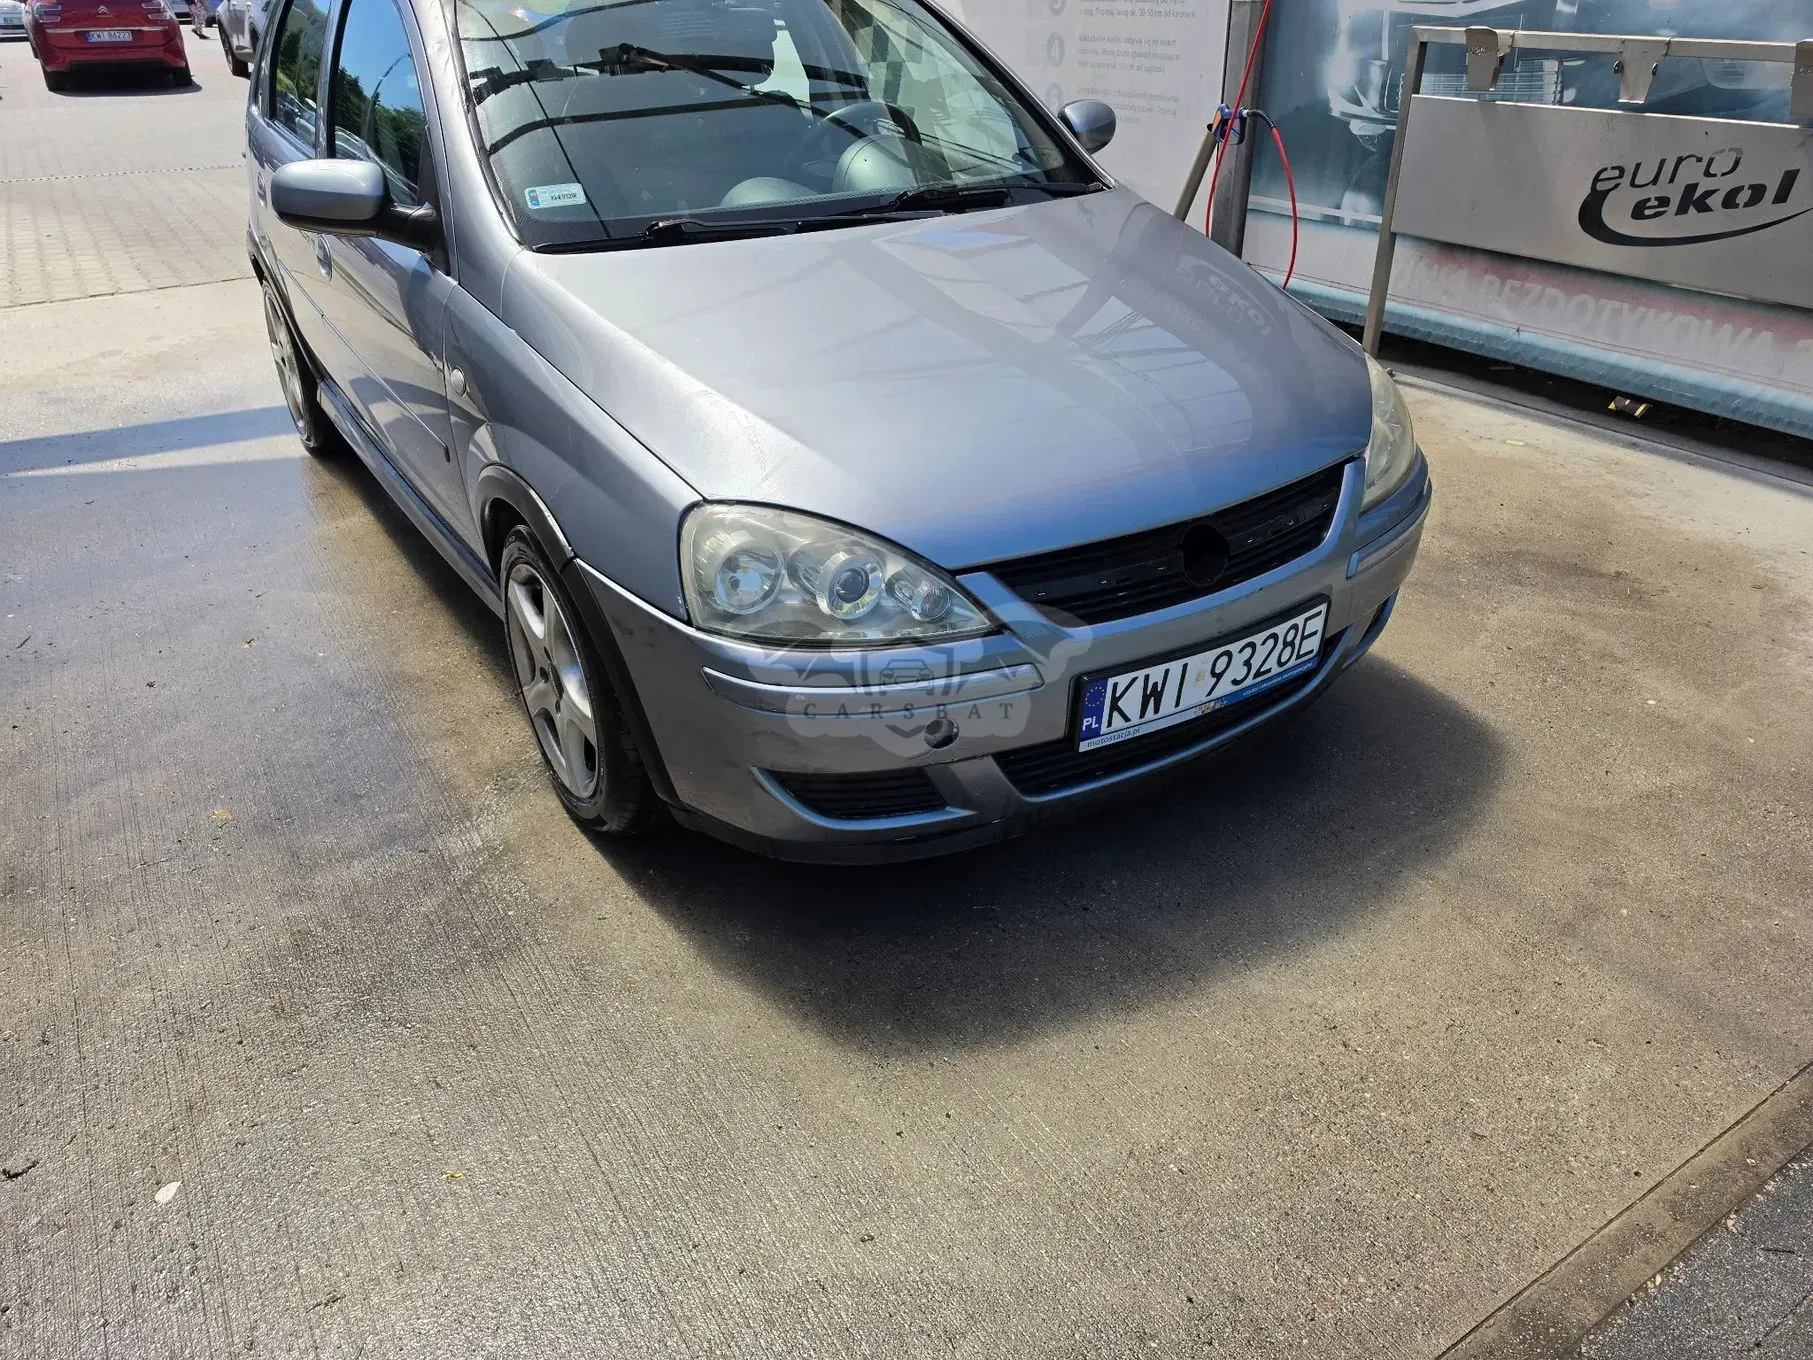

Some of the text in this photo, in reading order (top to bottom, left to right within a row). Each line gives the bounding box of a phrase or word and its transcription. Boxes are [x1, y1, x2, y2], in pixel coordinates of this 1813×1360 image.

[1591, 147, 1744, 192] euro
[1630, 168, 1801, 220] ekol
[1106, 609, 1323, 729] KWI 9328E
[1082, 715, 1099, 731] PL
[1087, 727, 1141, 748] motostacja.pl
